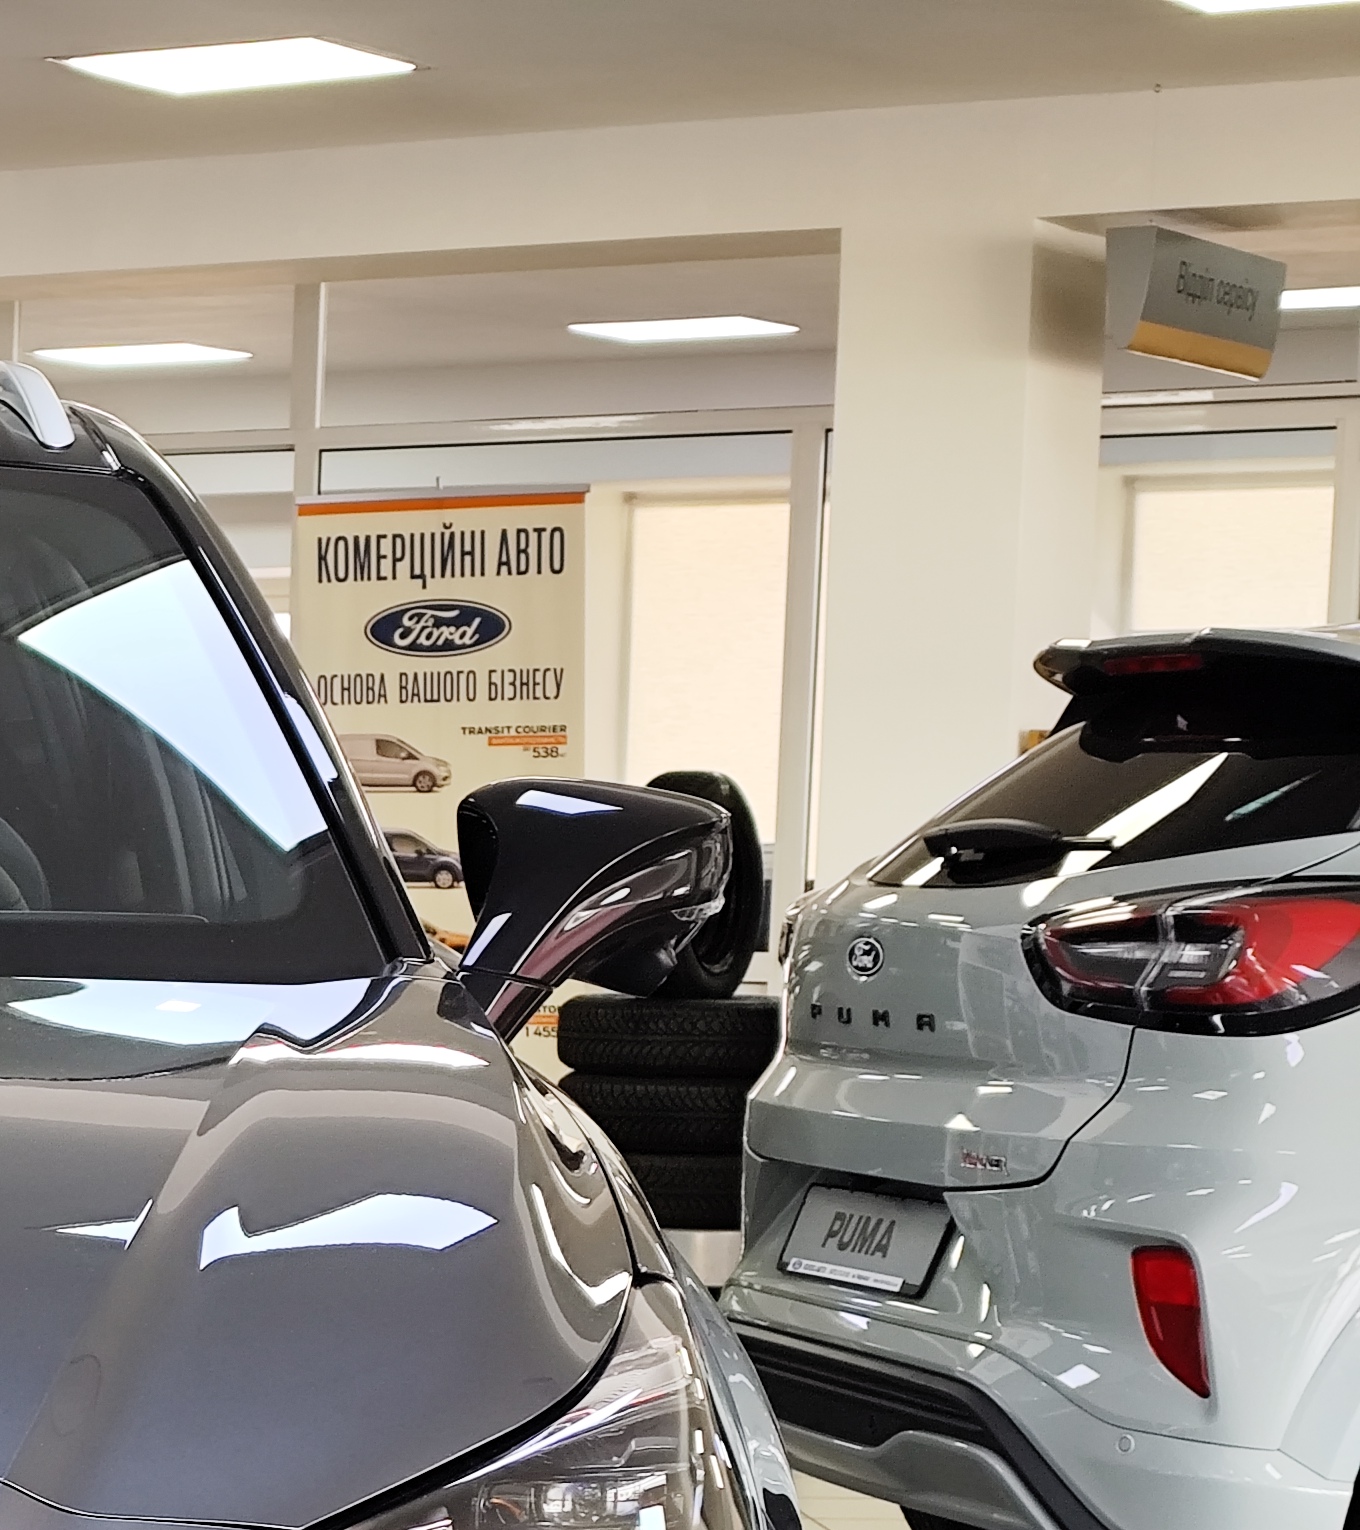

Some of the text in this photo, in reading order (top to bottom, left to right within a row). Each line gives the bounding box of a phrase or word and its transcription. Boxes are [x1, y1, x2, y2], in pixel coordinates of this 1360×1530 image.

[317, 522, 565, 589] КОМЕРЦІЙНІ АВТО
[393, 608, 482, 647] Ford
[317, 667, 564, 706] ОСНОВА ВАШОГО БІЗНЕСУ
[461, 724, 567, 735] TRANSIT COURIER
[810, 1003, 936, 1033] PUMA
[821, 1211, 896, 1258] PUMA
